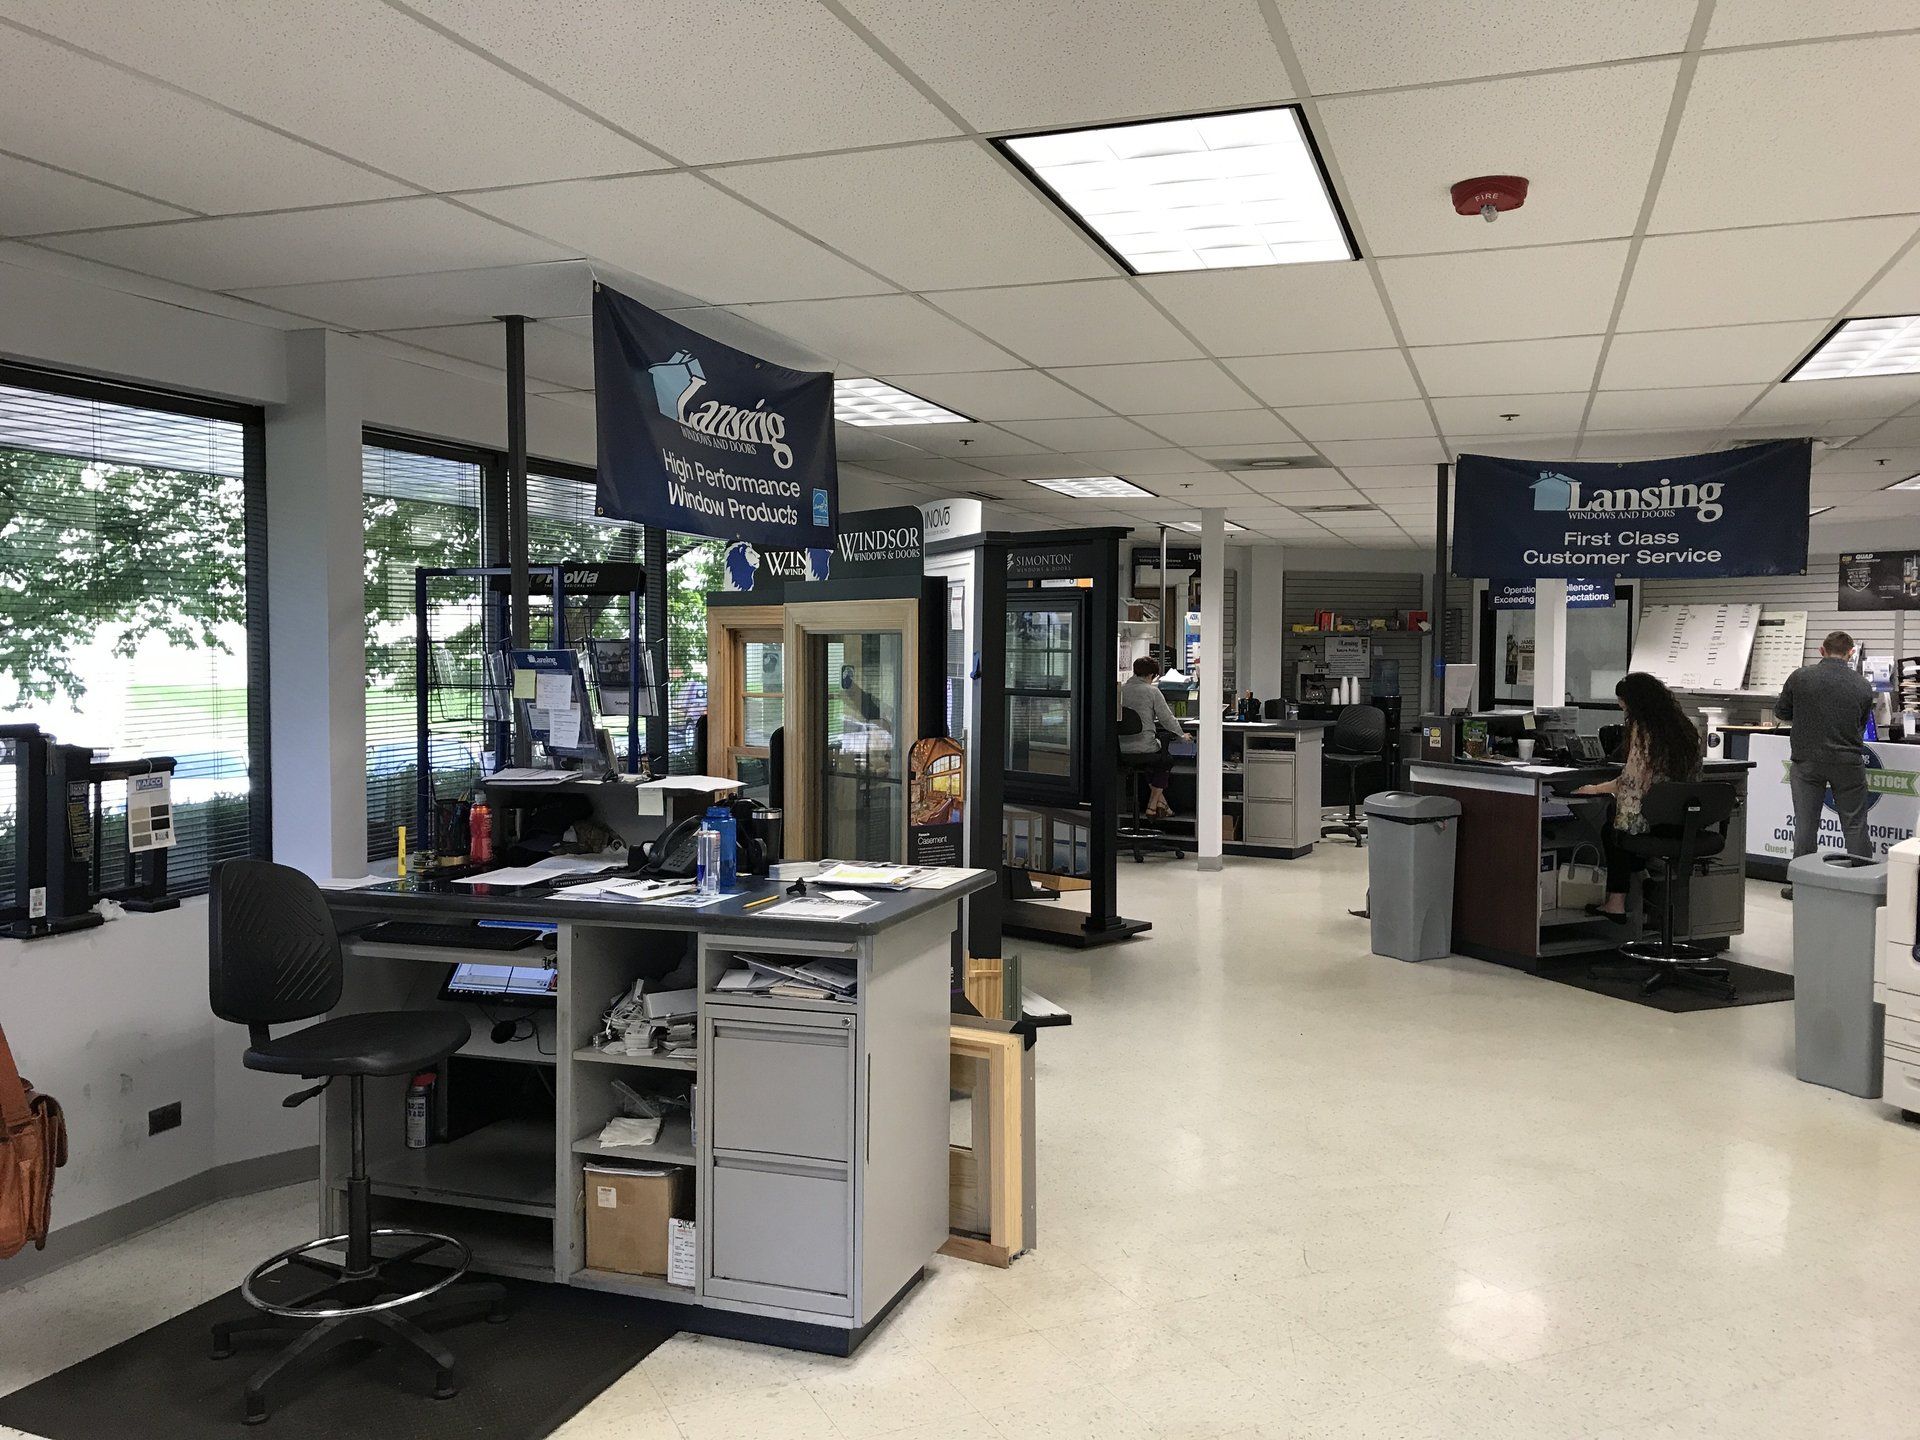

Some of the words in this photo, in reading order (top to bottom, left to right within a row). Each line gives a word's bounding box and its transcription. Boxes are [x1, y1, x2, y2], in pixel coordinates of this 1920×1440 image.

[1474, 192, 1500, 202] FIRE
[677, 376, 793, 469] Lansing
[680, 426, 712, 448] WINDOWS
[713, 438, 729, 451] AND
[730, 442, 757, 455] DOORS
[662, 448, 693, 483] High
[694, 461, 800, 498] Performance
[667, 481, 724, 517] Window
[727, 498, 798, 526] Products
[1567, 478, 1725, 523] Lansing
[1568, 511, 1616, 520] WINDOWS
[1617, 511, 1640, 519] AND
[1641, 509, 1676, 518] DOORS
[838, 527, 920, 562] WINDSOR
[1564, 531, 1611, 546] First
[1618, 531, 1680, 545] Class
[854, 551, 887, 562] WINDOWS
[887, 551, 894, 560] &
[895, 549, 920, 560] DOORS
[1016, 554, 1072, 567] SIMONTON
[1523, 550, 1630, 565] Customer
[1636, 548, 1722, 564] Service
[1503, 586, 1536, 595] Operatio
[1494, 596, 1535, 605] Exceeding
[1873, 775, 1909, 789] STOCK
[917, 836, 948, 845] Casement
[1764, 843, 1787, 854] Quest
